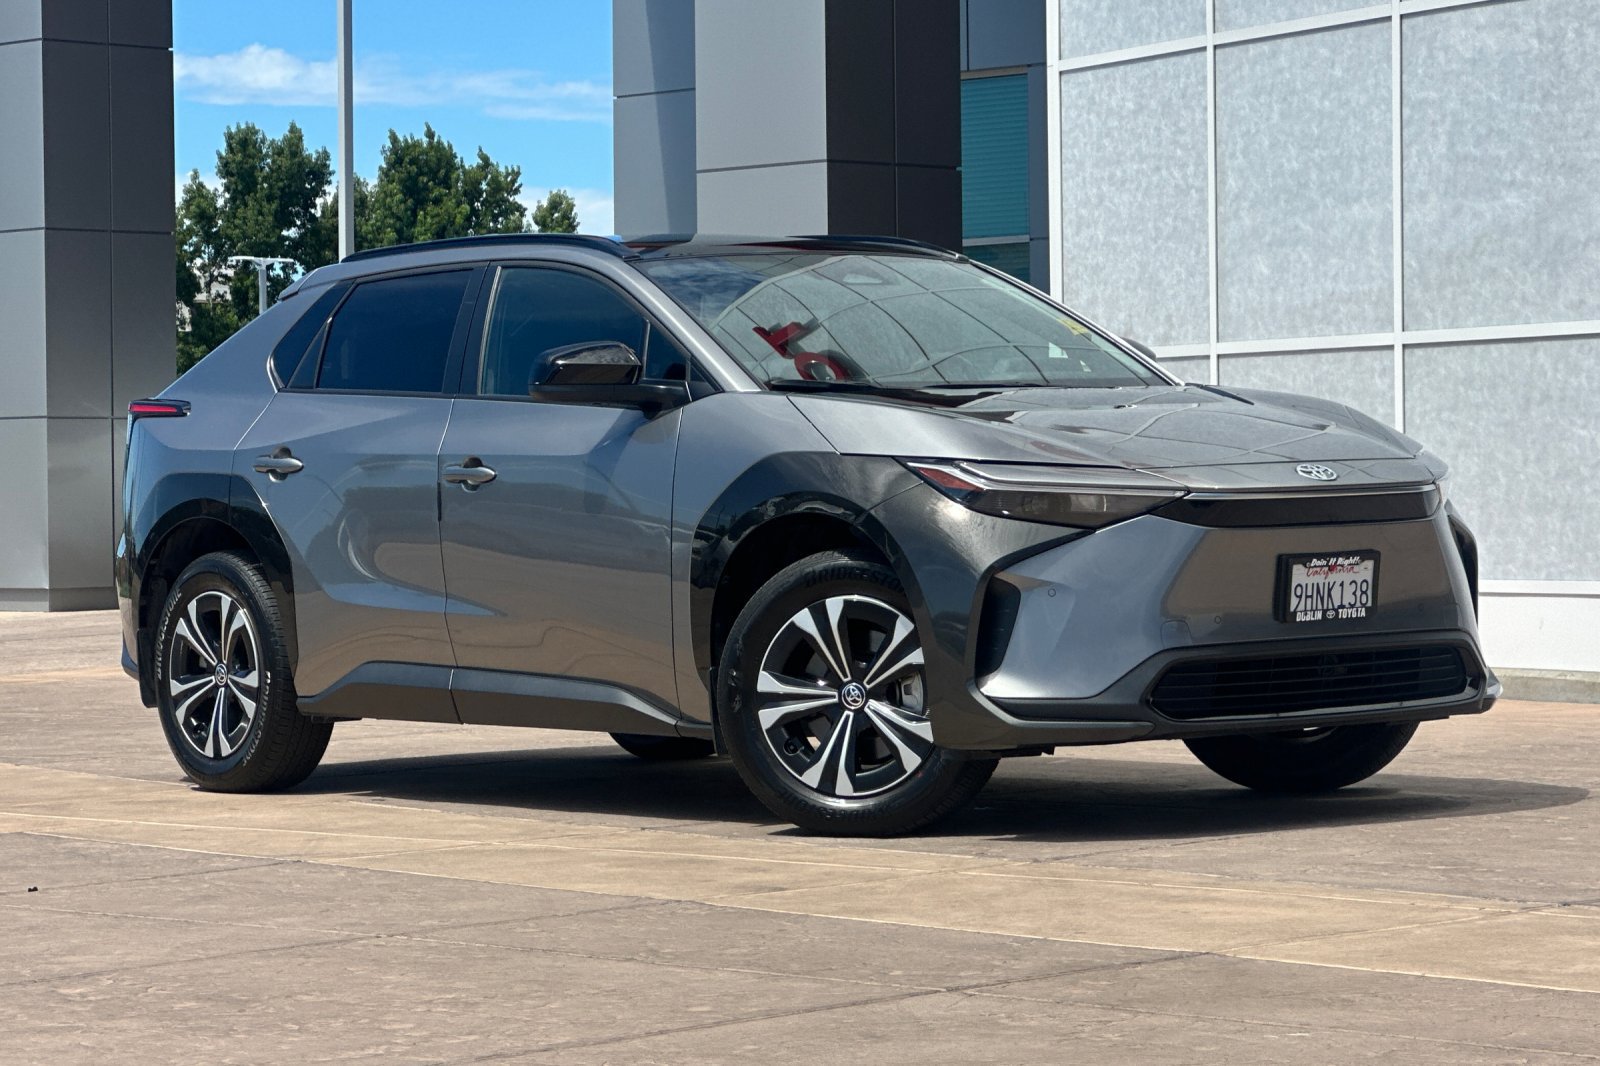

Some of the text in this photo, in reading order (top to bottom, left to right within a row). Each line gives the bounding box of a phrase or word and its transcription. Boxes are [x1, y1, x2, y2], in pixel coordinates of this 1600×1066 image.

[1293, 579, 1369, 612] 9HNK138
[1296, 607, 1366, 622] DUBLIN TOYOTA
